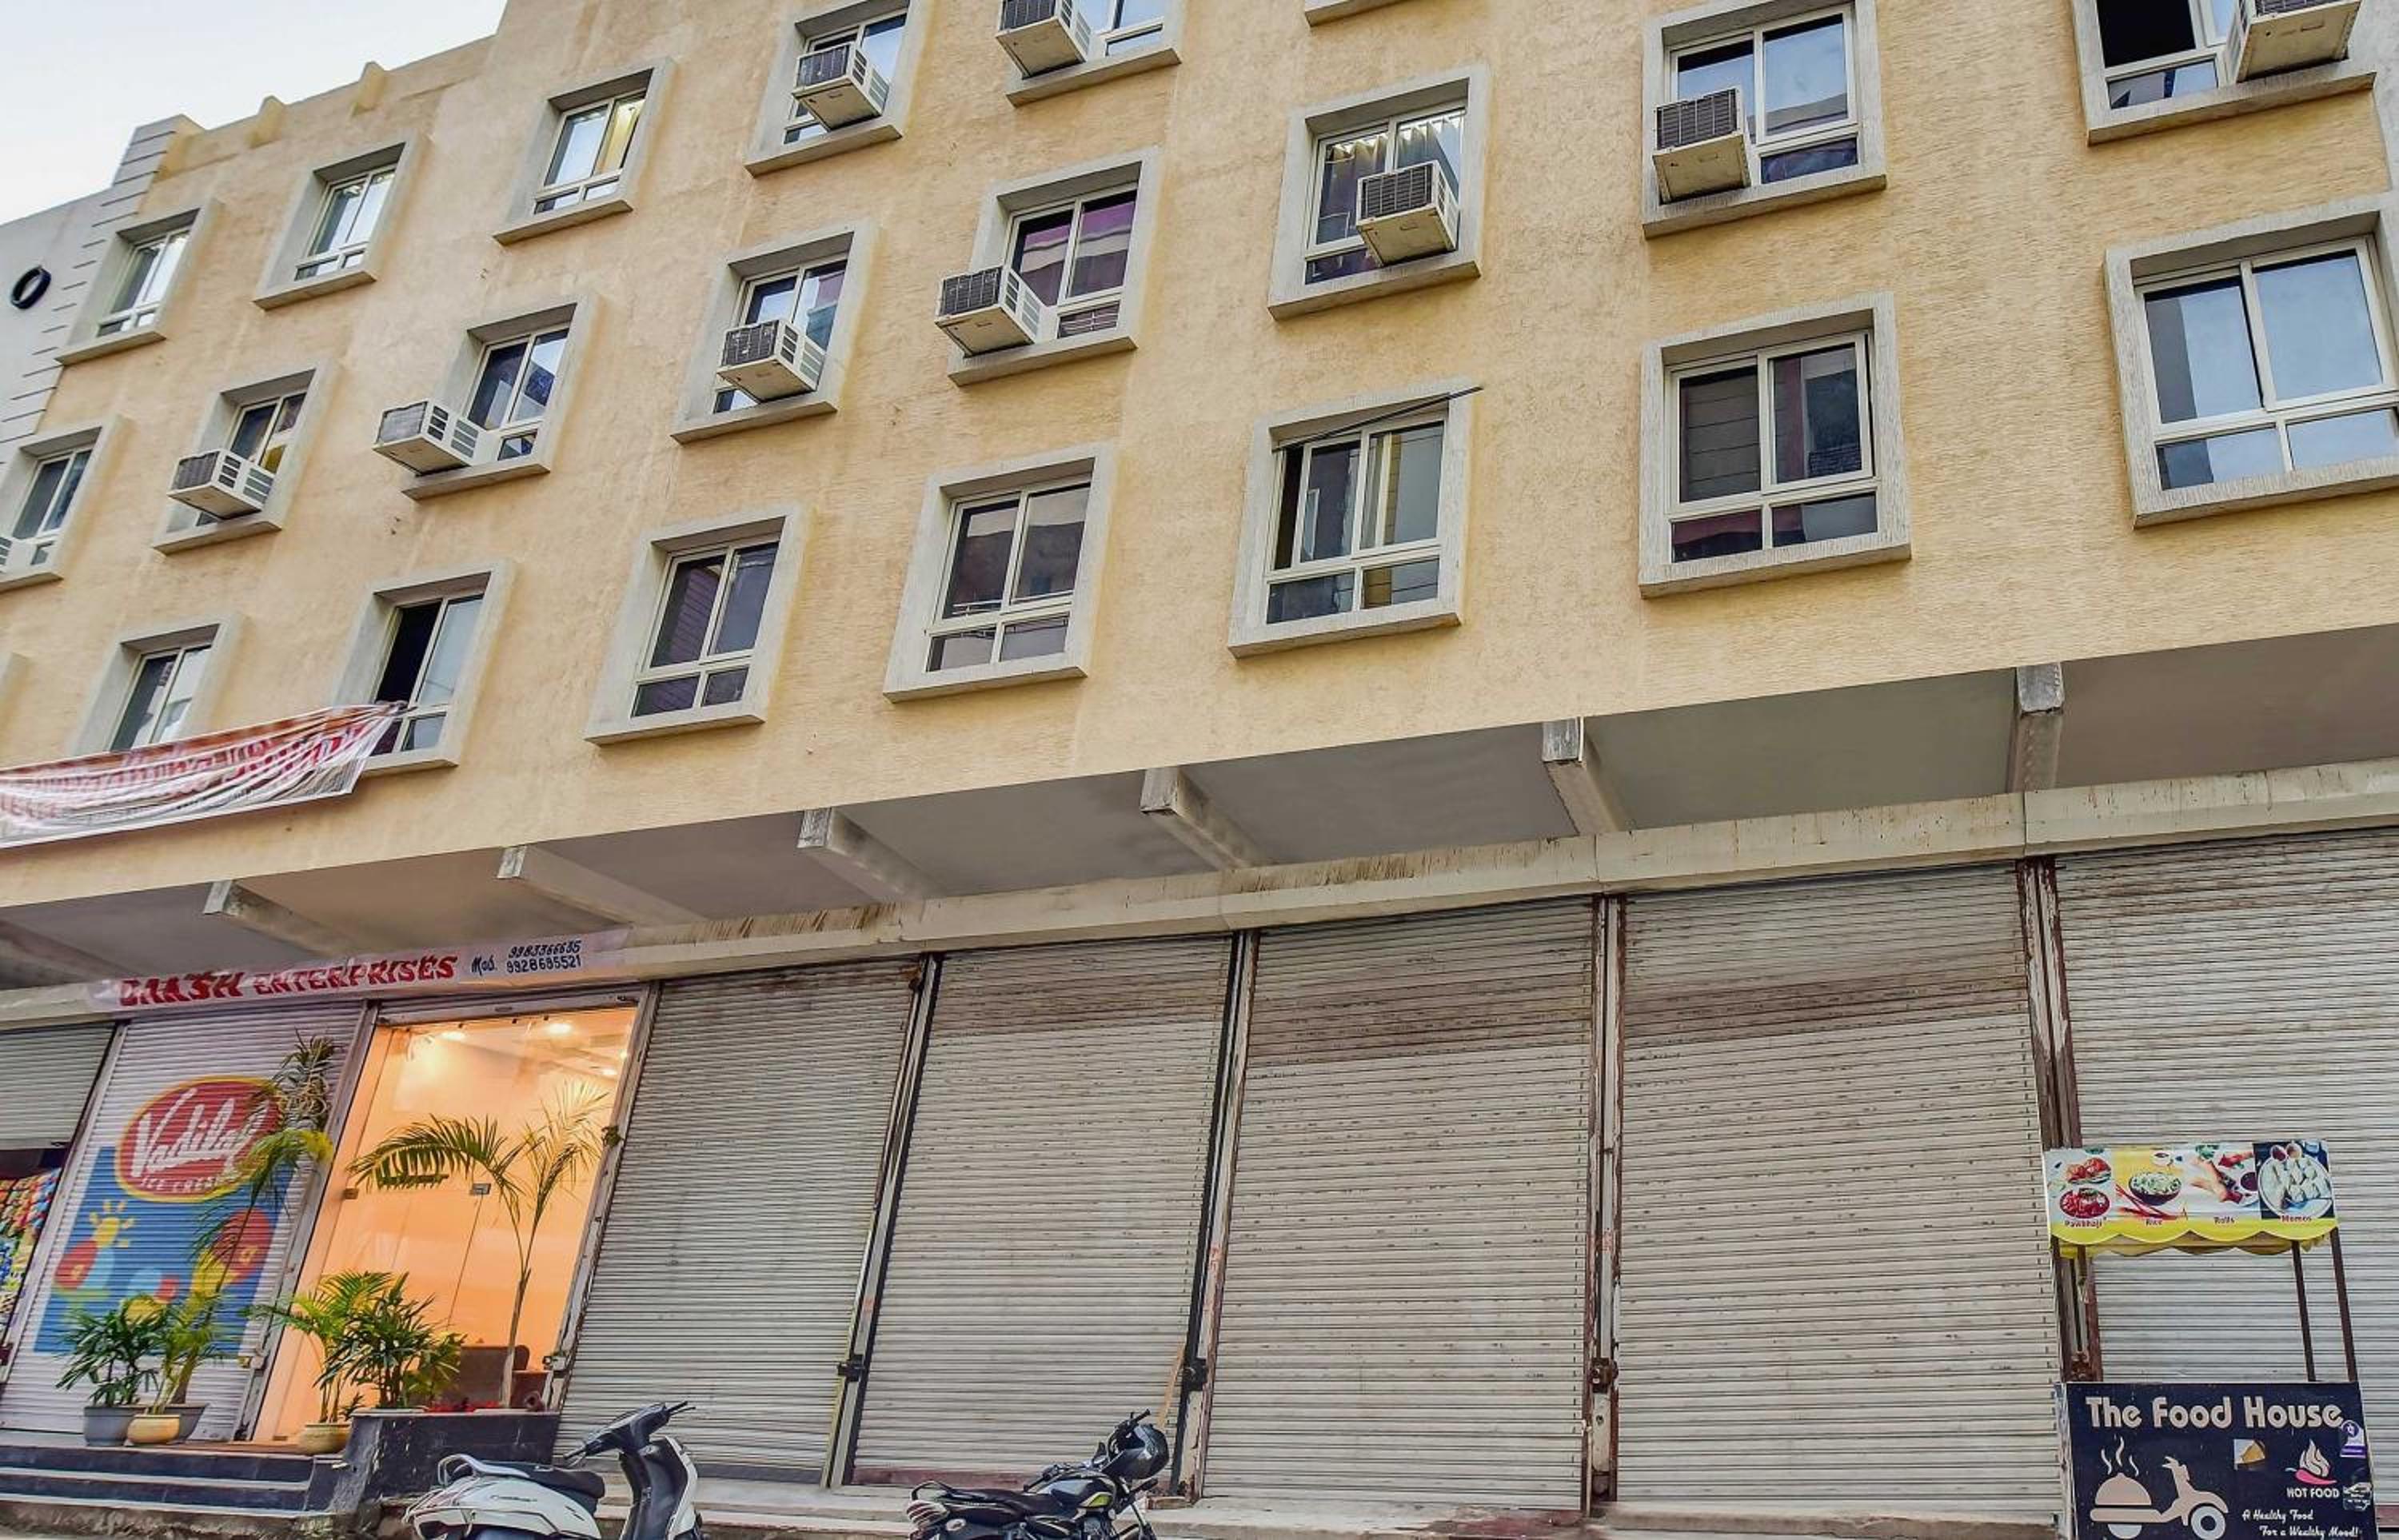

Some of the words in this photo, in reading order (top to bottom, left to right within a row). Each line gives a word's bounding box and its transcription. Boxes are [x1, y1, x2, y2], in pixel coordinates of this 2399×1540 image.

[253, 955, 458, 995] ENTERPRISES
[2085, 1396, 2142, 1428] The
[2152, 1396, 2233, 1429] Food
[2243, 1395, 2344, 1429] House
[2286, 1487, 2308, 1498] HOT
[2310, 1488, 2340, 1498] FOOD
[2241, 1509, 2252, 1521] A
[2253, 1509, 2287, 1523] Healthy
[2289, 1509, 2314, 1521] Food
[2259, 1525, 2277, 1537] For
[2289, 1525, 2325, 1540] Wealthy
